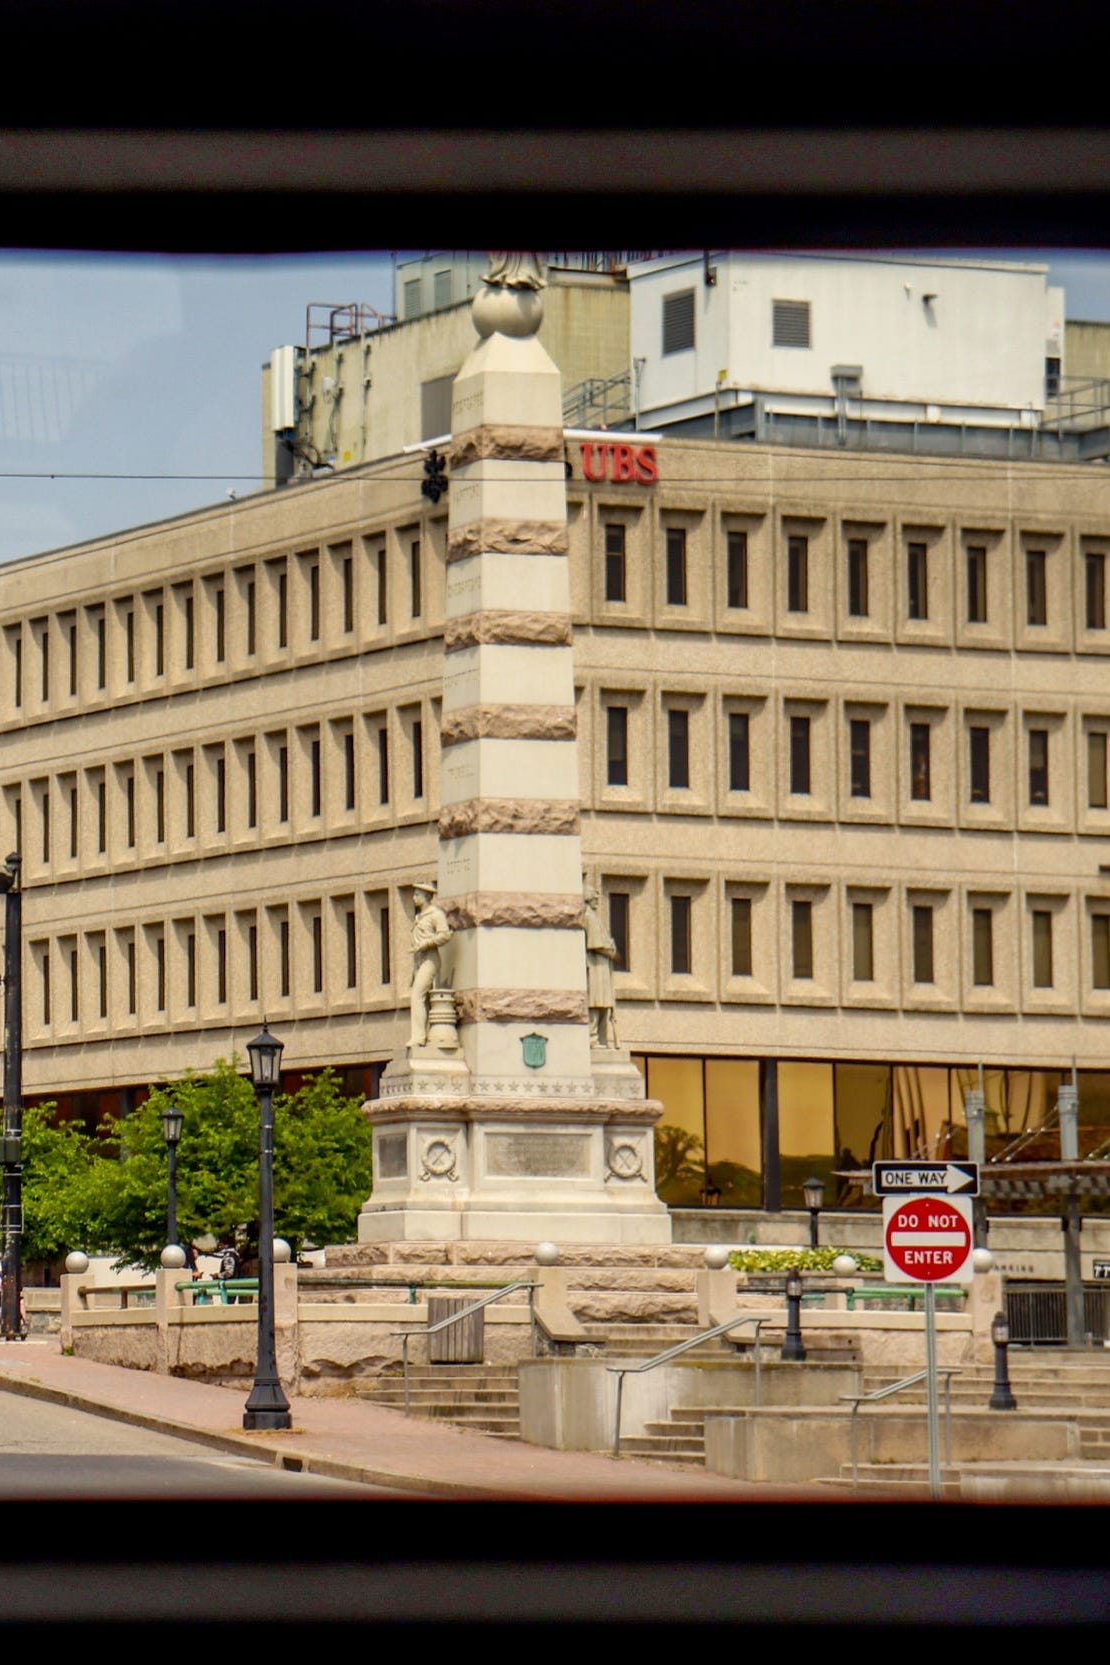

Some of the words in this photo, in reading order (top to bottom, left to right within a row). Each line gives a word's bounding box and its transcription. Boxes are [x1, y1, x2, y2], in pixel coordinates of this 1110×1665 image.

[580, 443, 658, 485] UBS
[885, 1172, 912, 1185] ONE
[918, 1172, 947, 1185] WAY
[898, 1215, 919, 1228] DO
[928, 1215, 958, 1228] NOT
[904, 1251, 953, 1265] ENTER
